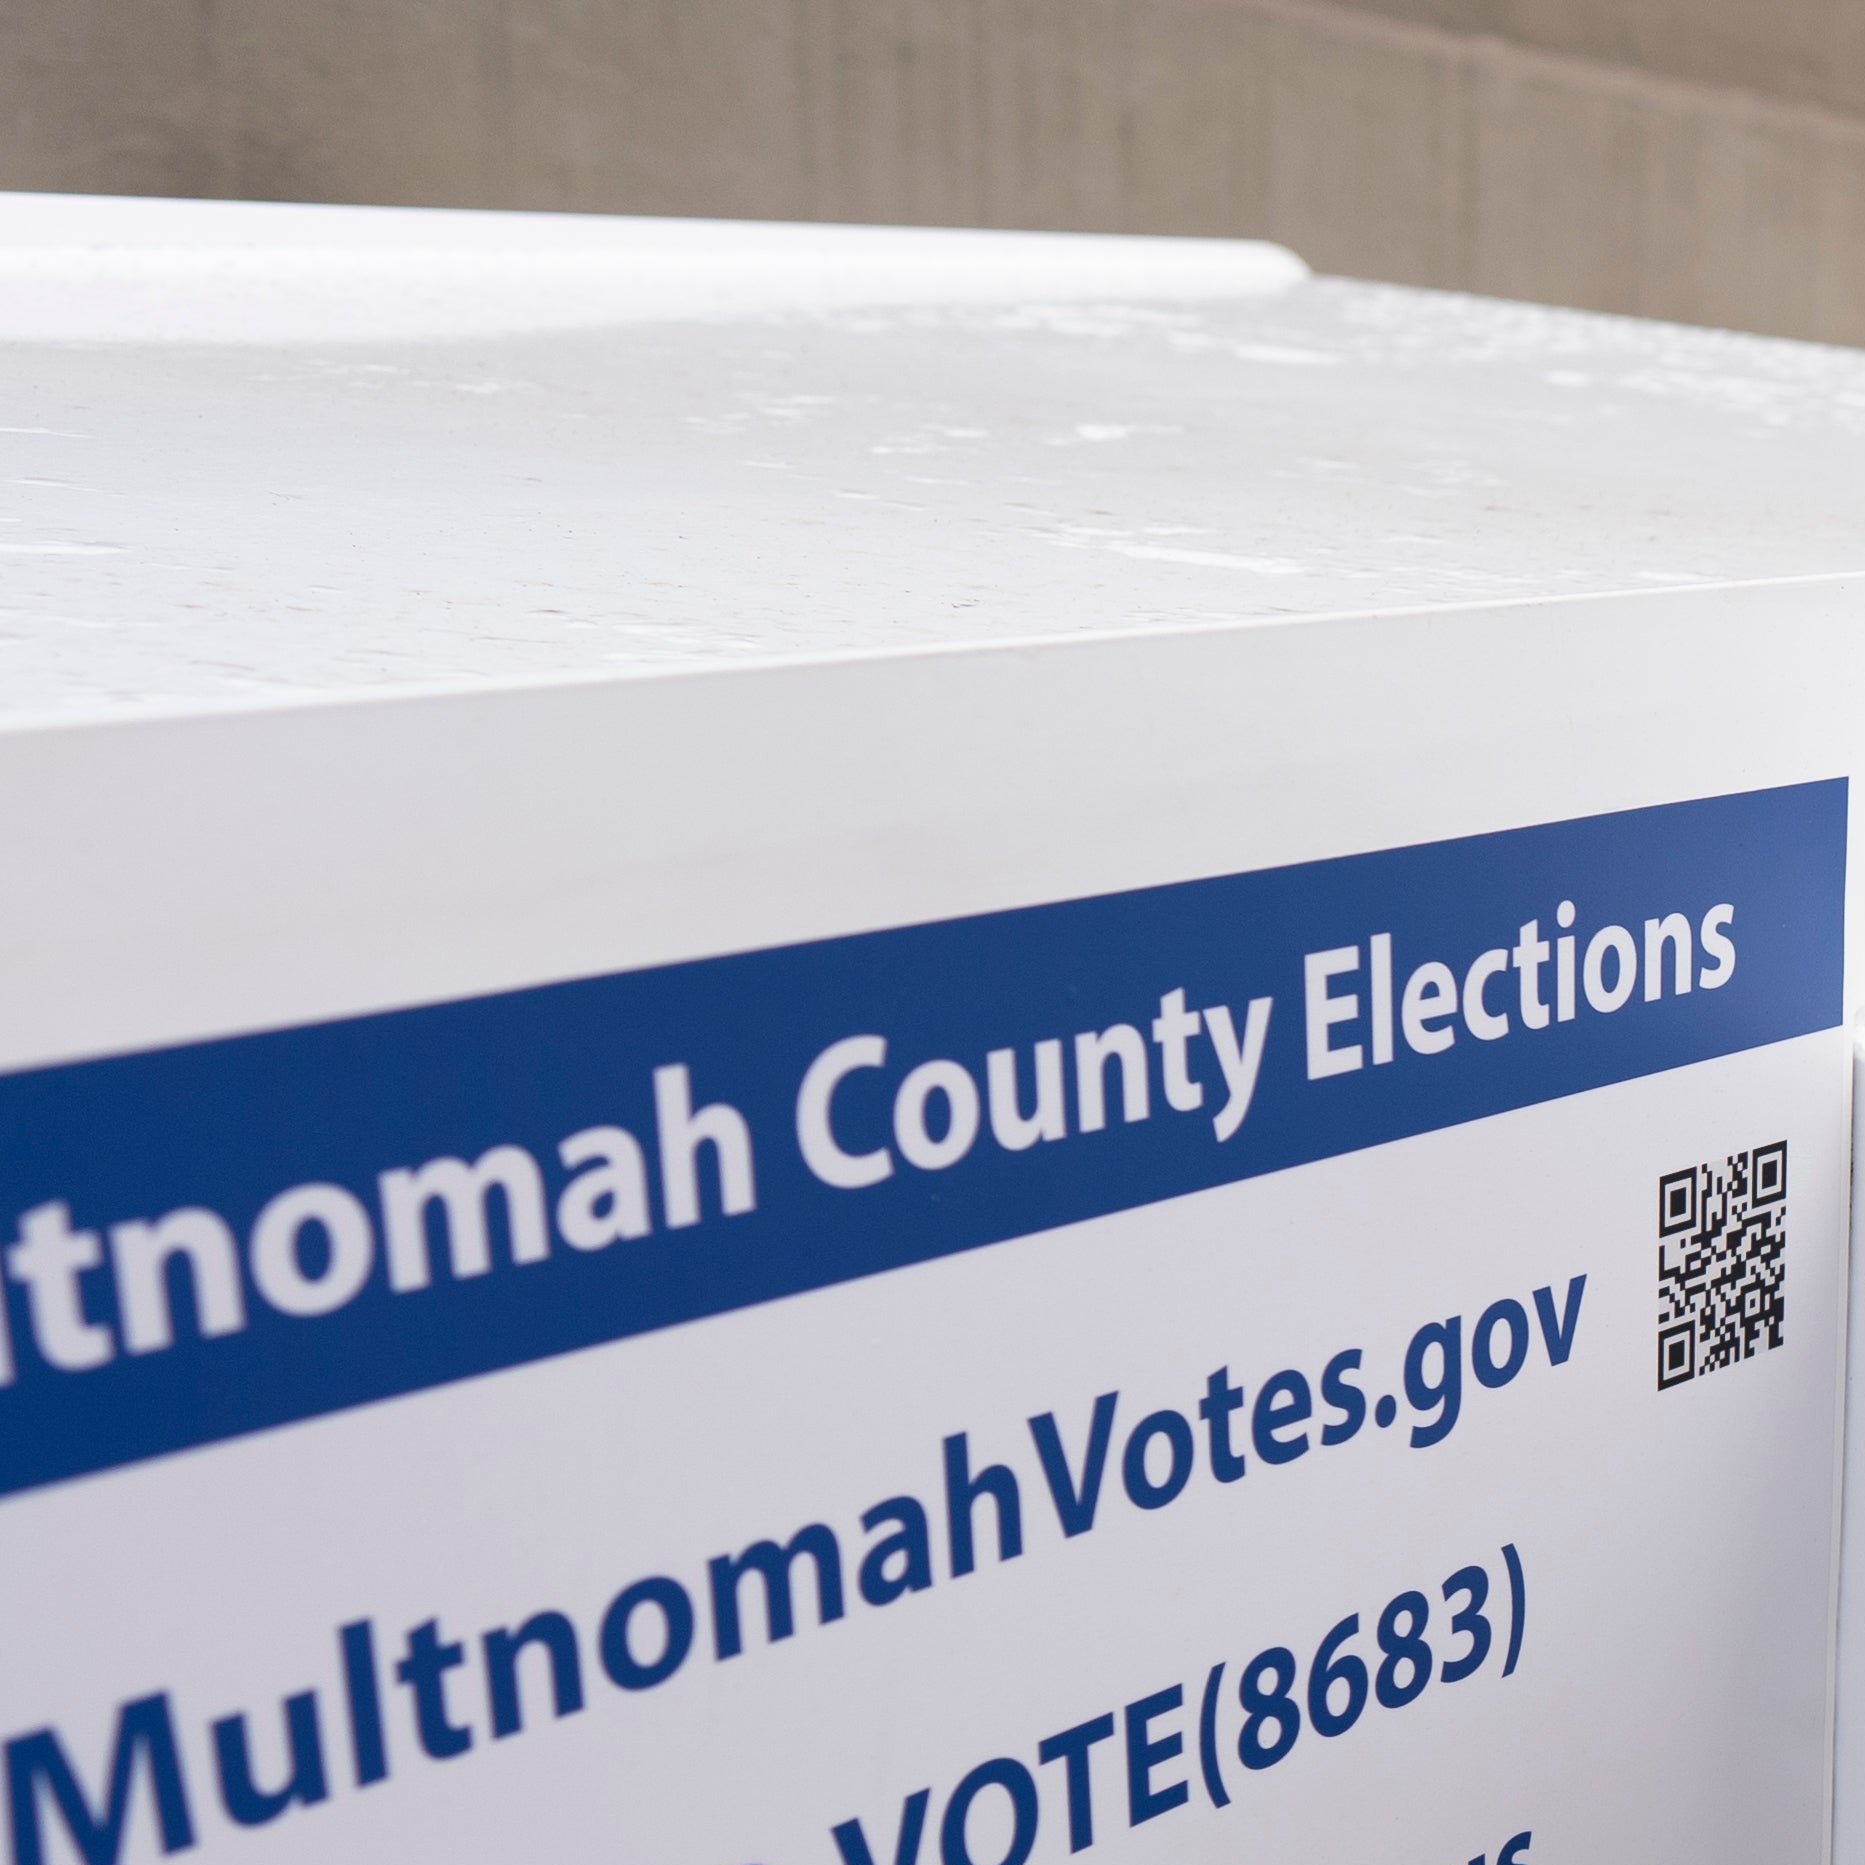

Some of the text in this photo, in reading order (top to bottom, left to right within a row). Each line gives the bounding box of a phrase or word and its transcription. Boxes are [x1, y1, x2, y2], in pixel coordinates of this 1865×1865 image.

[0, 900, 1737, 1386] tnomah County Elections
